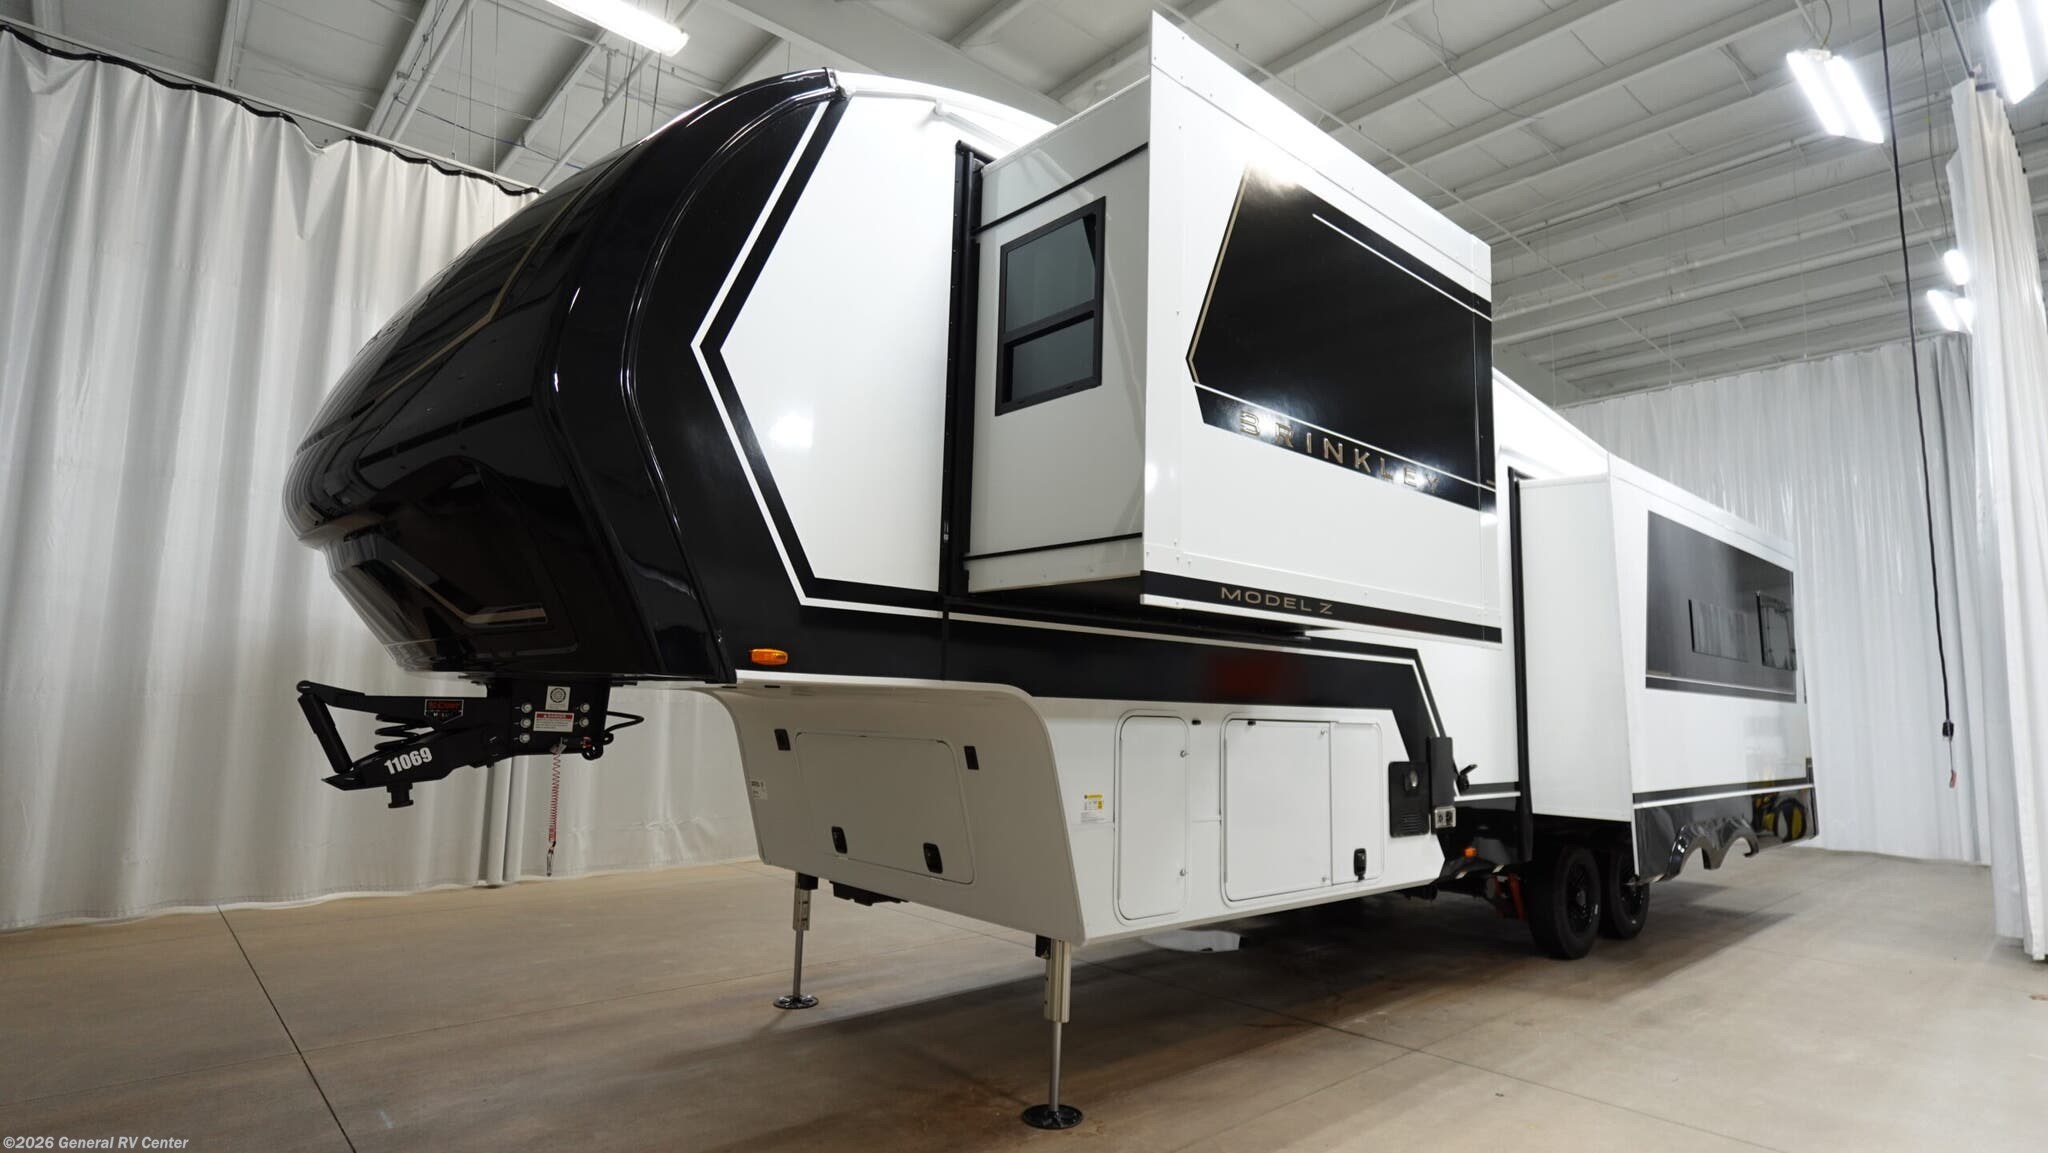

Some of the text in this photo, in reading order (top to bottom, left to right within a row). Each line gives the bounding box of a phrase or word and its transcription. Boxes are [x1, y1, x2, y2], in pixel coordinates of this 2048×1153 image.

[1240, 410, 1440, 494] BRINKLEY
[1220, 586, 1334, 615] MODEL Z
[384, 747, 433, 775] 11069
